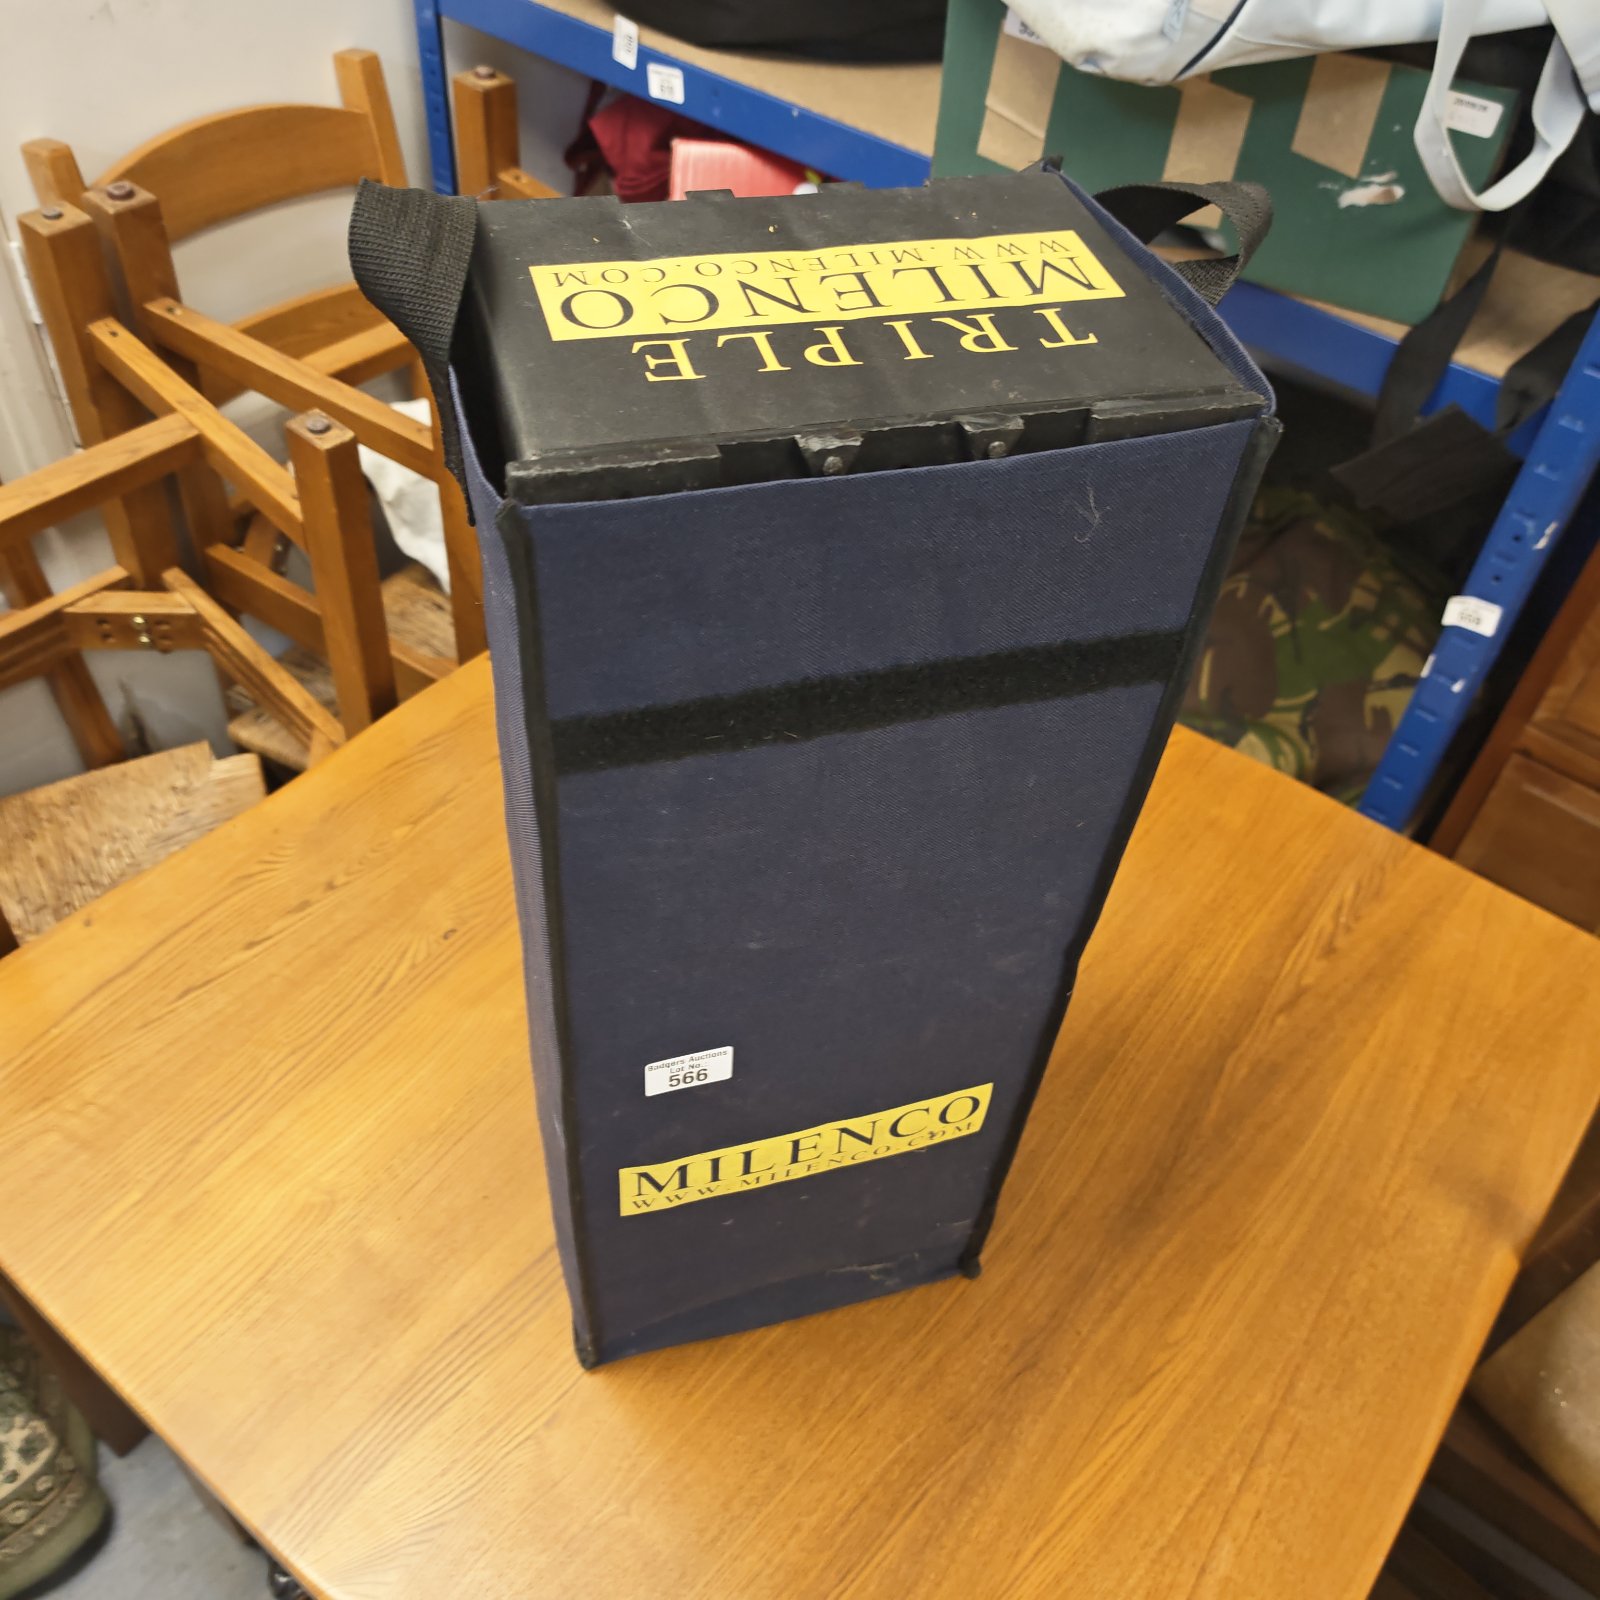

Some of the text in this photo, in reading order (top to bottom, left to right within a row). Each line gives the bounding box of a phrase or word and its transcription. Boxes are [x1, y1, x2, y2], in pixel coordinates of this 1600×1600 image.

[560, 256, 1105, 330] MILENCO
[631, 307, 1099, 382] TRIPLE
[648, 1050, 728, 1071] Badgers Auctions
[668, 1068, 708, 1088] 566
[631, 1095, 980, 1197] MILENCO
